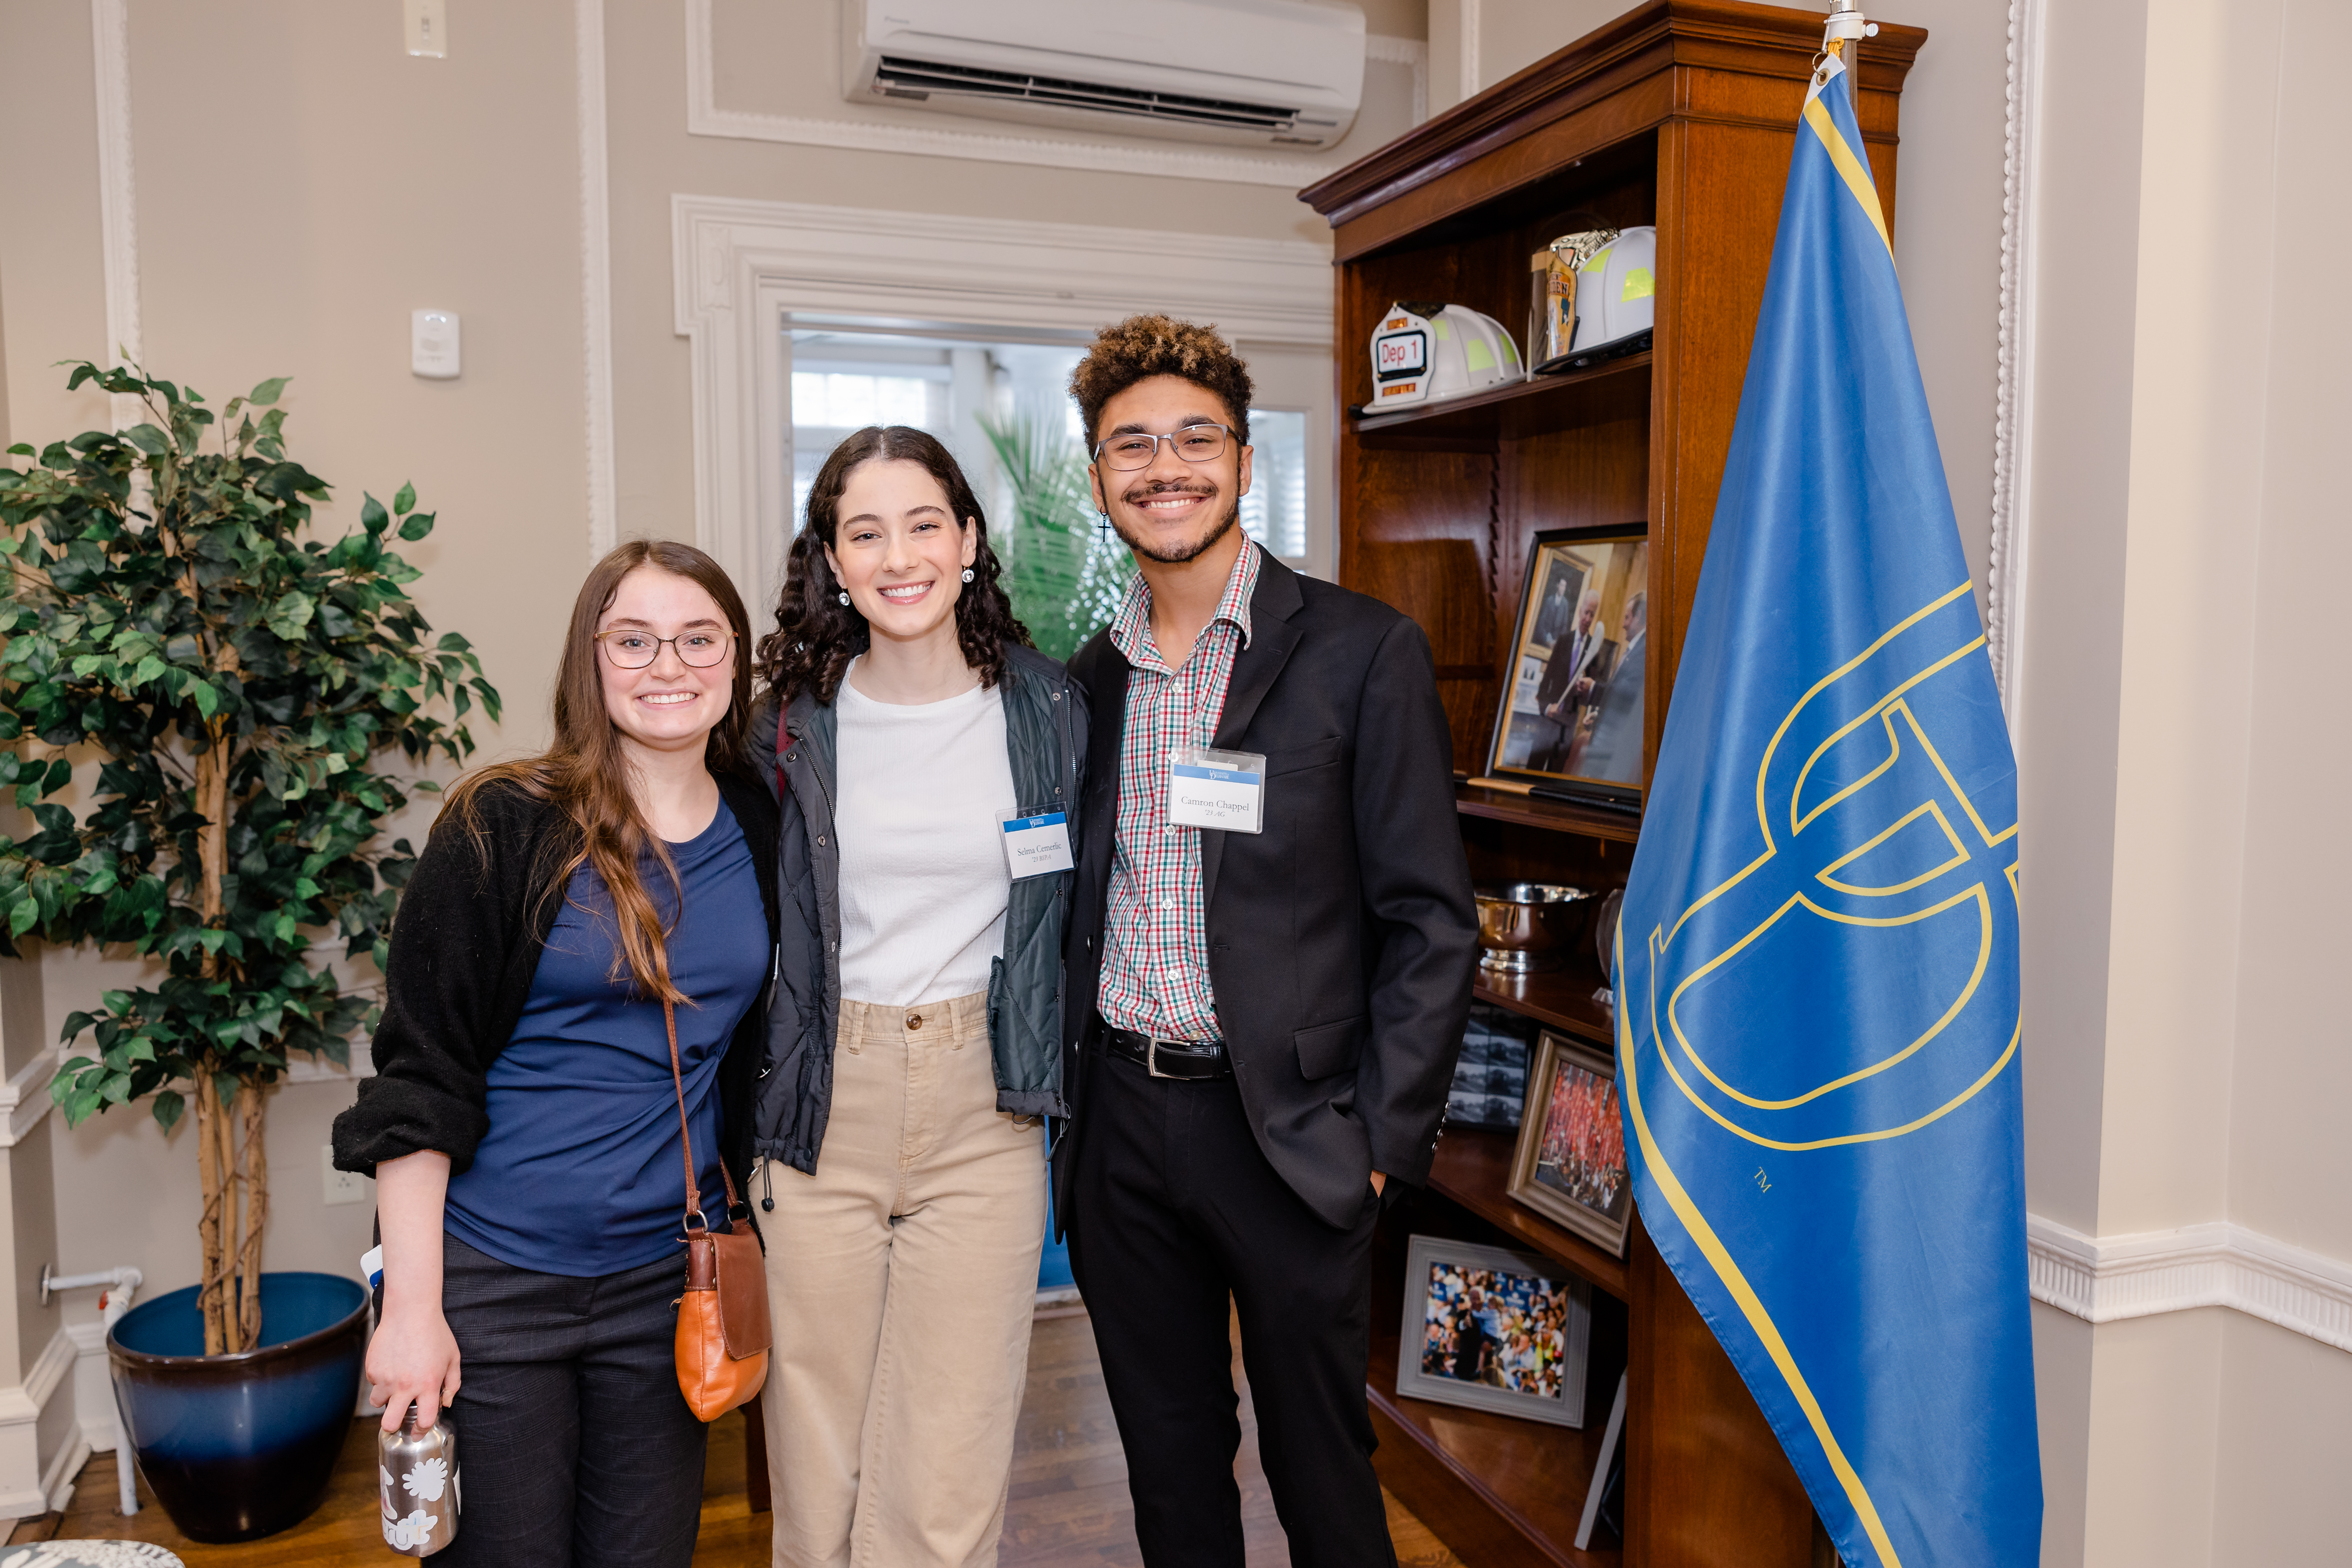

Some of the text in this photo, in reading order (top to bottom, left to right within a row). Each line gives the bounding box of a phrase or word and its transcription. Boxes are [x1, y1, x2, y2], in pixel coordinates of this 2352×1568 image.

[1382, 339, 1416, 366] Dep 1
[1181, 796, 1249, 812] Camron Chappel
[1017, 842, 1061, 856] Selma Cemerlic
[1754, 1166, 1772, 1194] TM
